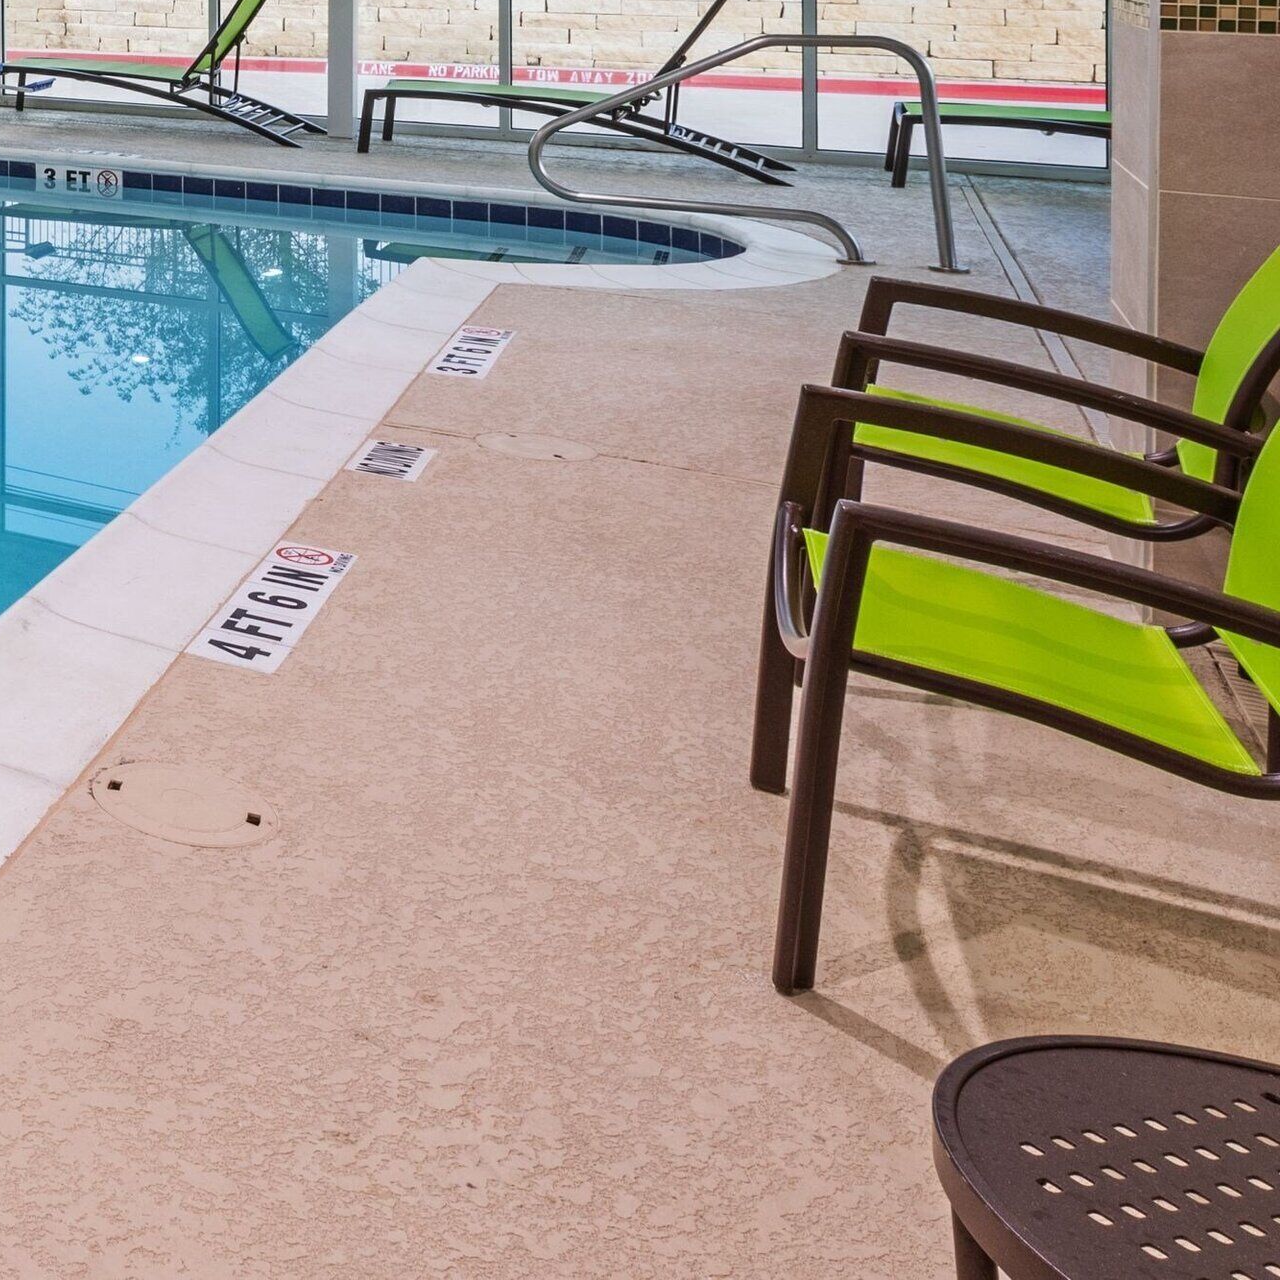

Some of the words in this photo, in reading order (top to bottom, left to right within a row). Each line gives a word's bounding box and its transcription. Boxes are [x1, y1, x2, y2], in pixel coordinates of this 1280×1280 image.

[361, 62, 396, 75] LANE
[428, 65, 447, 77] NO
[452, 65, 499, 79] PARKIN
[527, 69, 559, 81] TOW
[570, 71, 613, 83] AWAY
[458, 335, 501, 347] IN
[452, 346, 492, 354] 6
[442, 353, 487, 367] FT
[436, 366, 478, 375] 3
[262, 565, 329, 592] IN
[247, 591, 308, 610] 6
[221, 607, 294, 642] FT
[208, 638, 272, 661] 4
